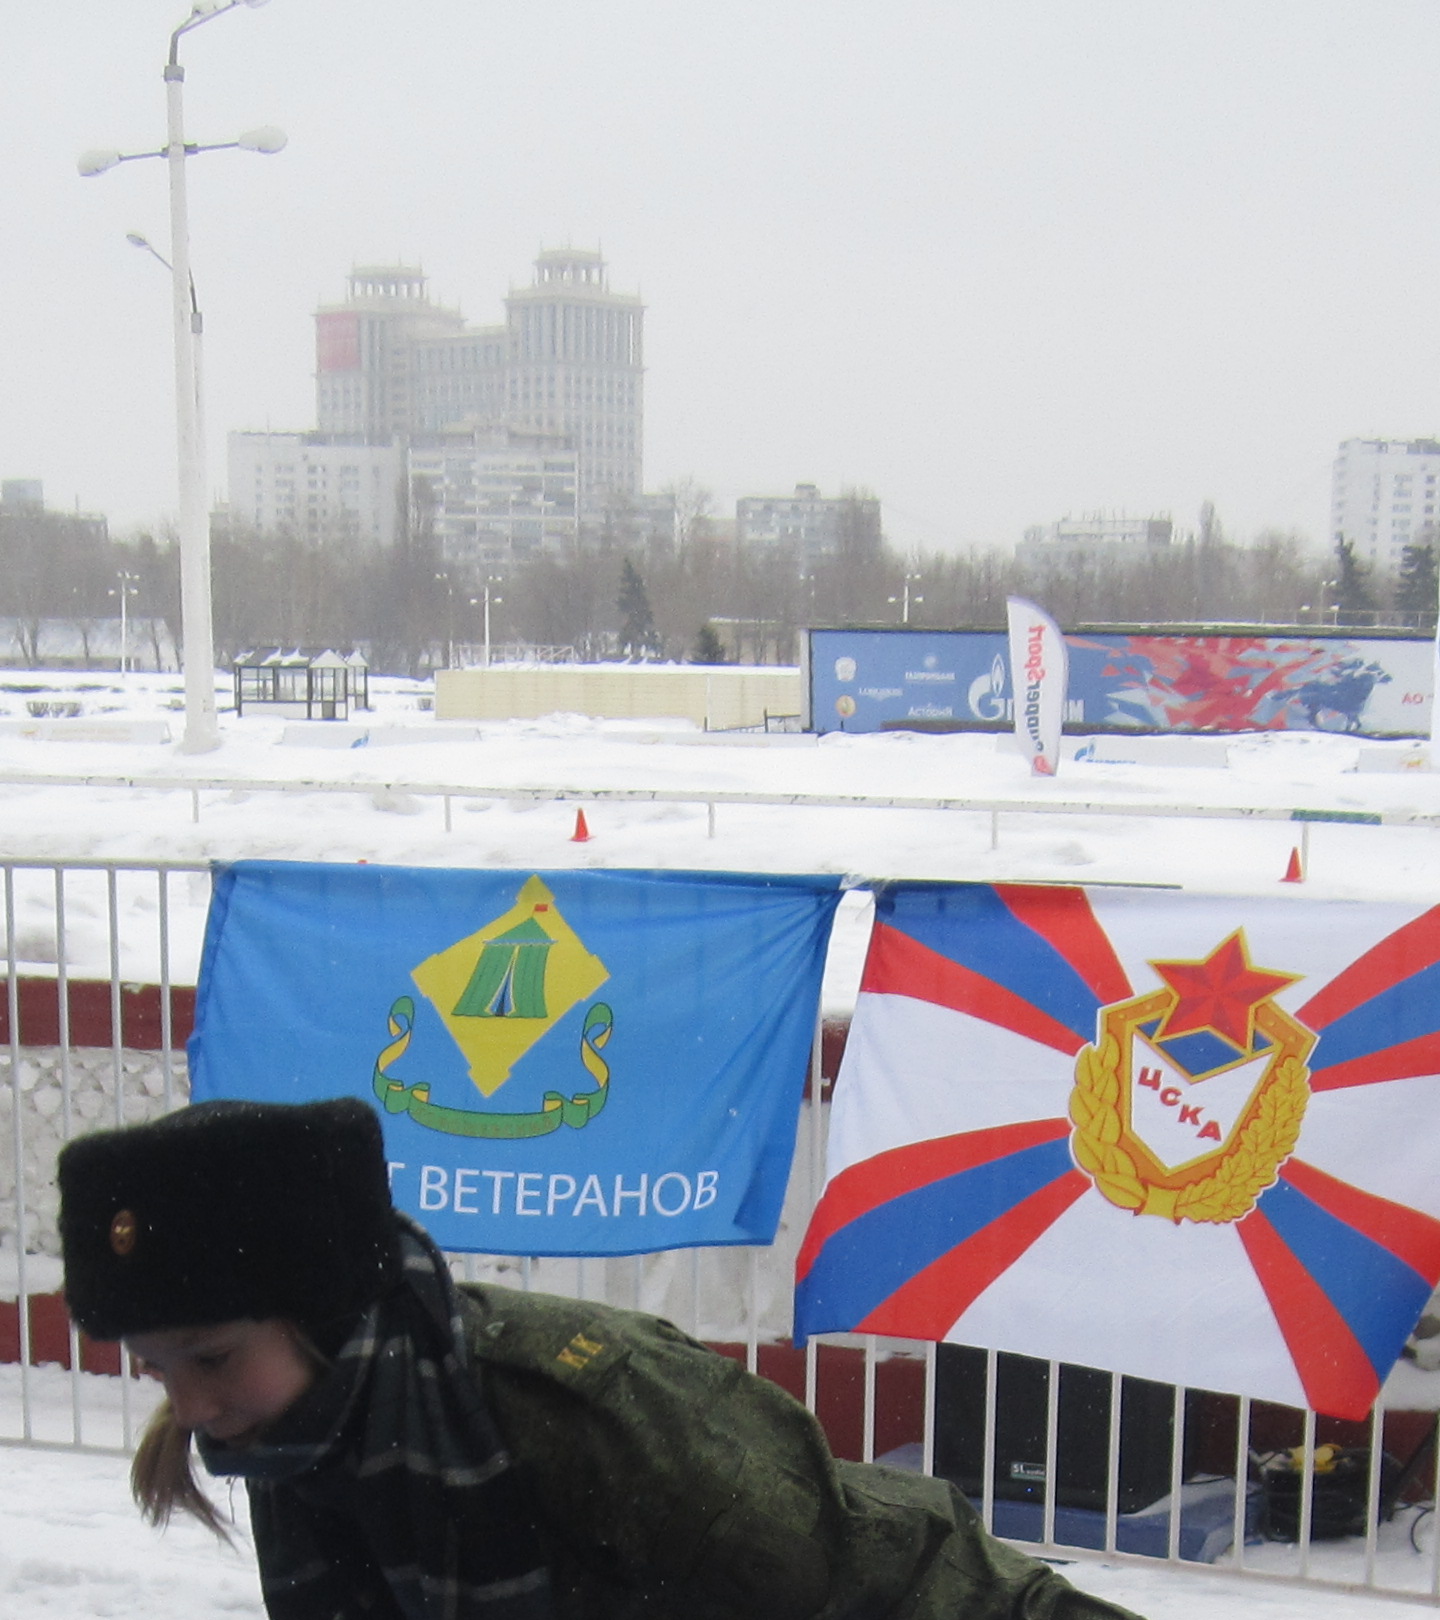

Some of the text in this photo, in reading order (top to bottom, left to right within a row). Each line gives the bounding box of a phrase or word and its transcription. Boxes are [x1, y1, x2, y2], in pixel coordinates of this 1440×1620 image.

[1401, 693, 1424, 705] АО
[1138, 1066, 1222, 1141] ЦСКА
[419, 1164, 719, 1217] ВЕТЕРАНОВ
